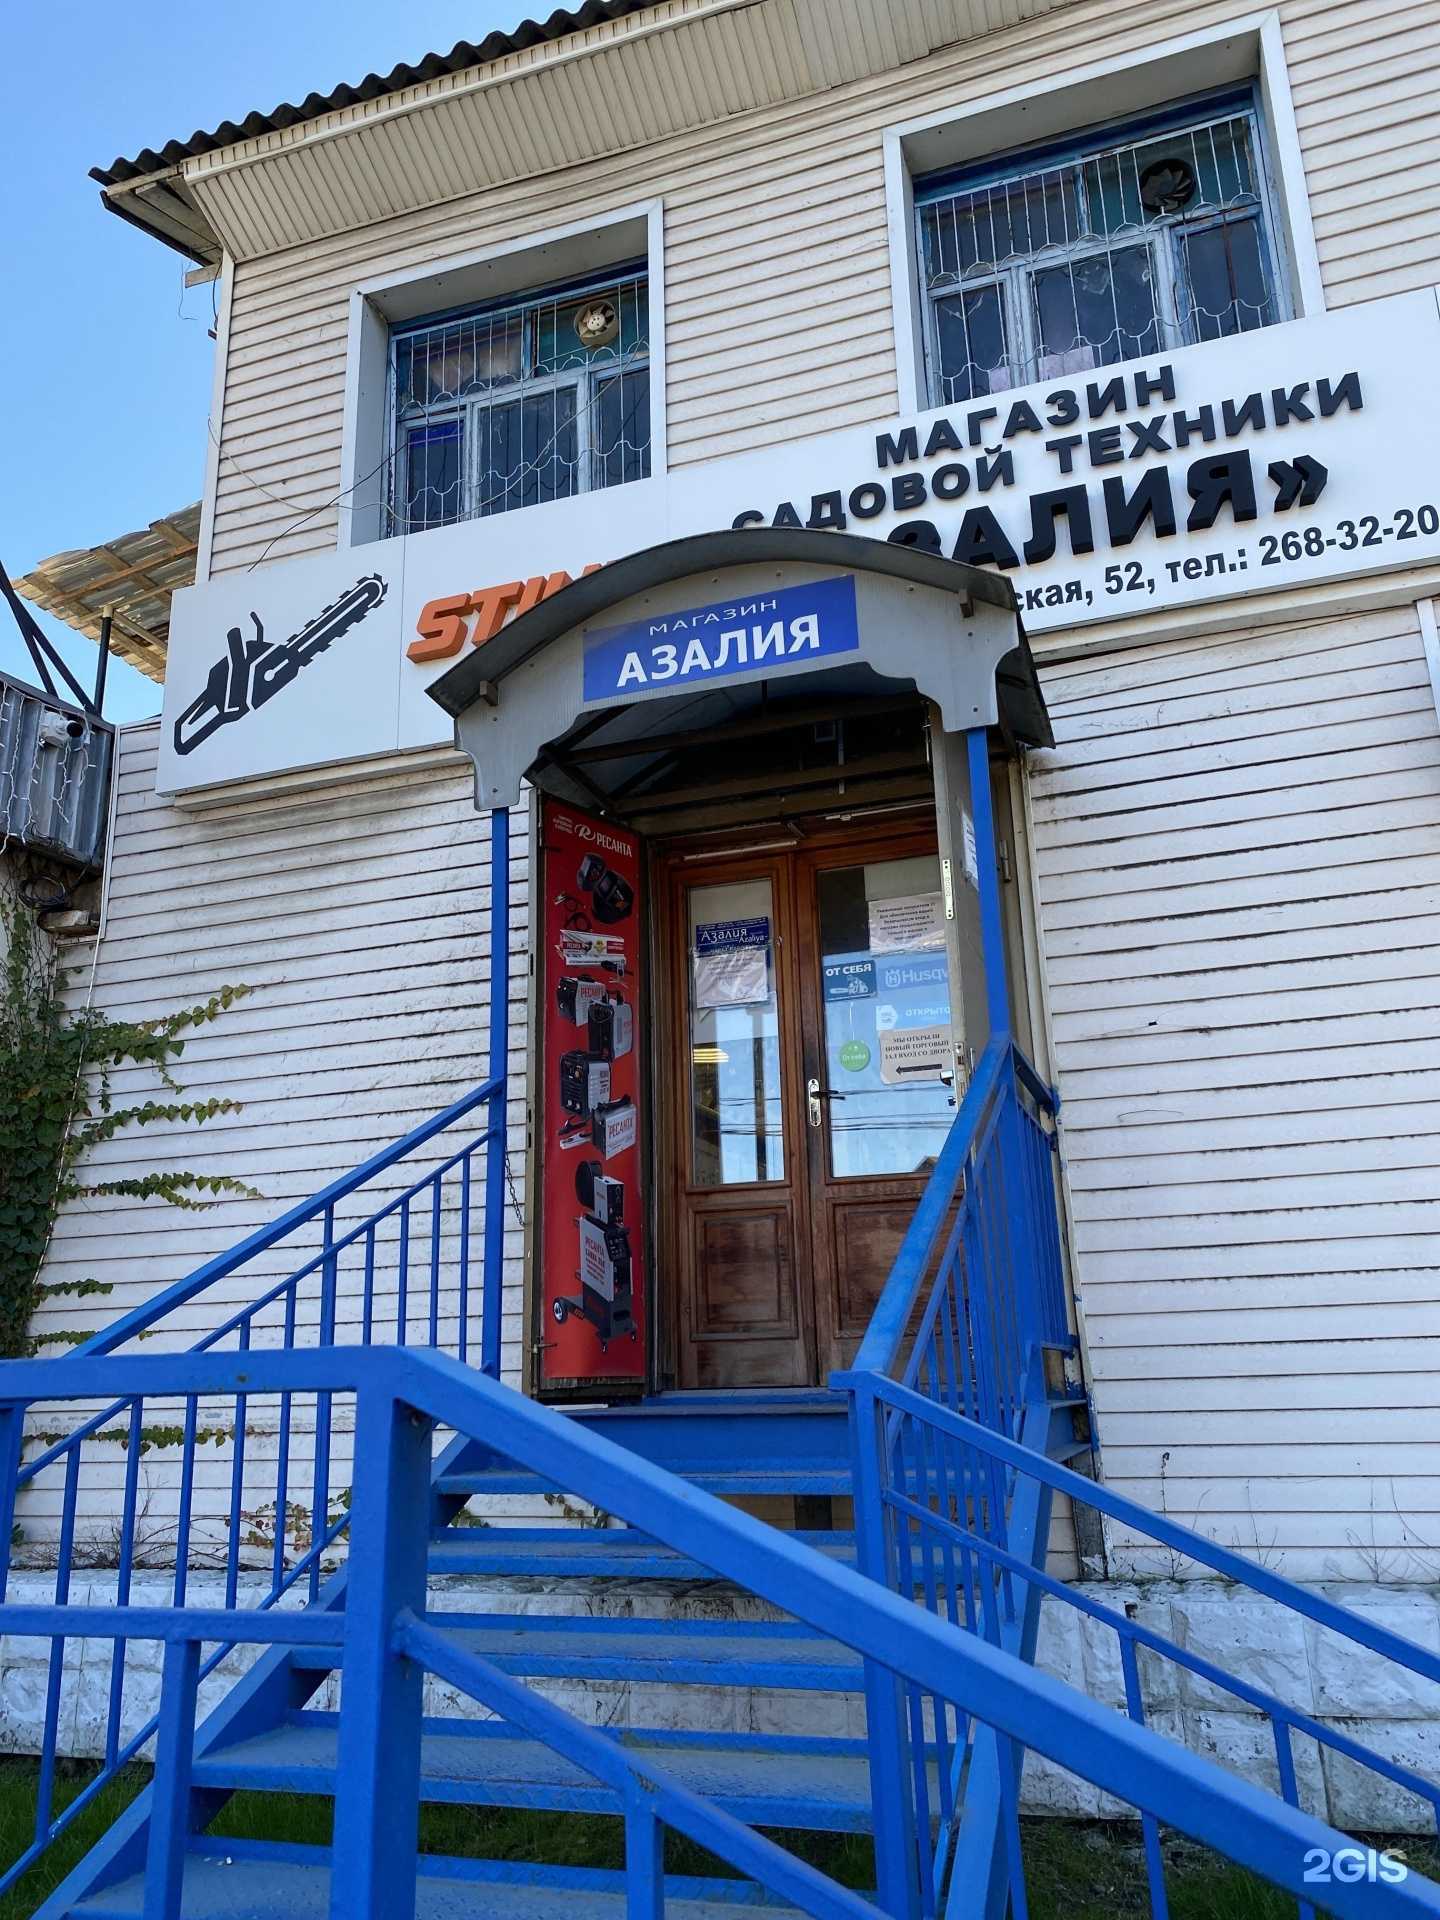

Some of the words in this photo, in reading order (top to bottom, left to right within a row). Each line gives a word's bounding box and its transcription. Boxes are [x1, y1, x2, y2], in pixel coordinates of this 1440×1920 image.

[874, 364, 1177, 468] МАГАЗИН
[1045, 371, 1364, 475] ТЕХНИКИ
[1015, 579, 1094, 611] ская,
[1104, 560, 1156, 596] 52,
[1165, 548, 1249, 584] тел.:
[1257, 504, 1440, 567] 268-32-20
[405, 560, 604, 665] STI
[615, 612, 823, 689] АЗАЛИЯ
[648, 598, 778, 637] МАГАЗИН
[596, 831, 633, 858] РЕСАНТА
[701, 928, 747, 943] Азалия
[825, 967, 841, 977] ОТ
[842, 963, 872, 975] СЕБЯ
